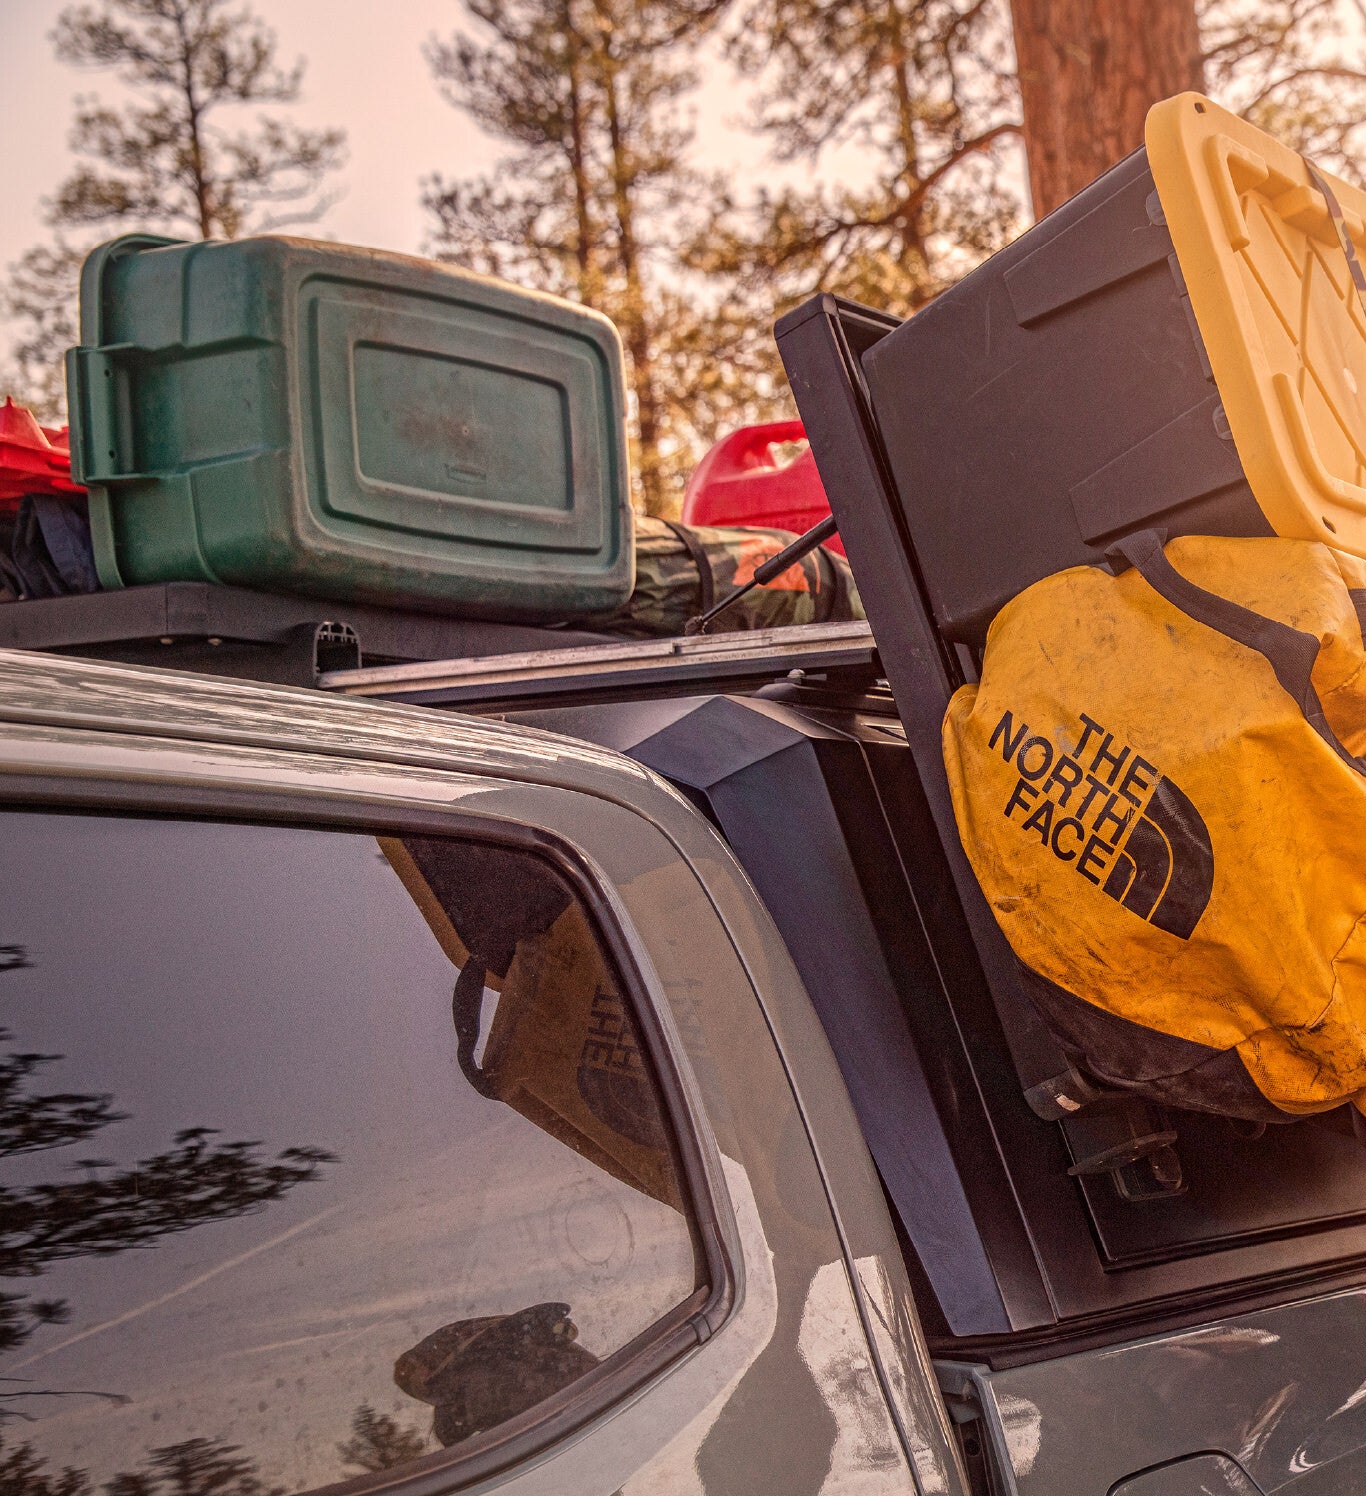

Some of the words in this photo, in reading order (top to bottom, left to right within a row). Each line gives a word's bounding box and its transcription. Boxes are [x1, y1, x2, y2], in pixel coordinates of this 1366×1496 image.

[988, 710, 1136, 847] NORTH
[1073, 712, 1158, 809] THE
[1004, 777, 1116, 886] FACE
